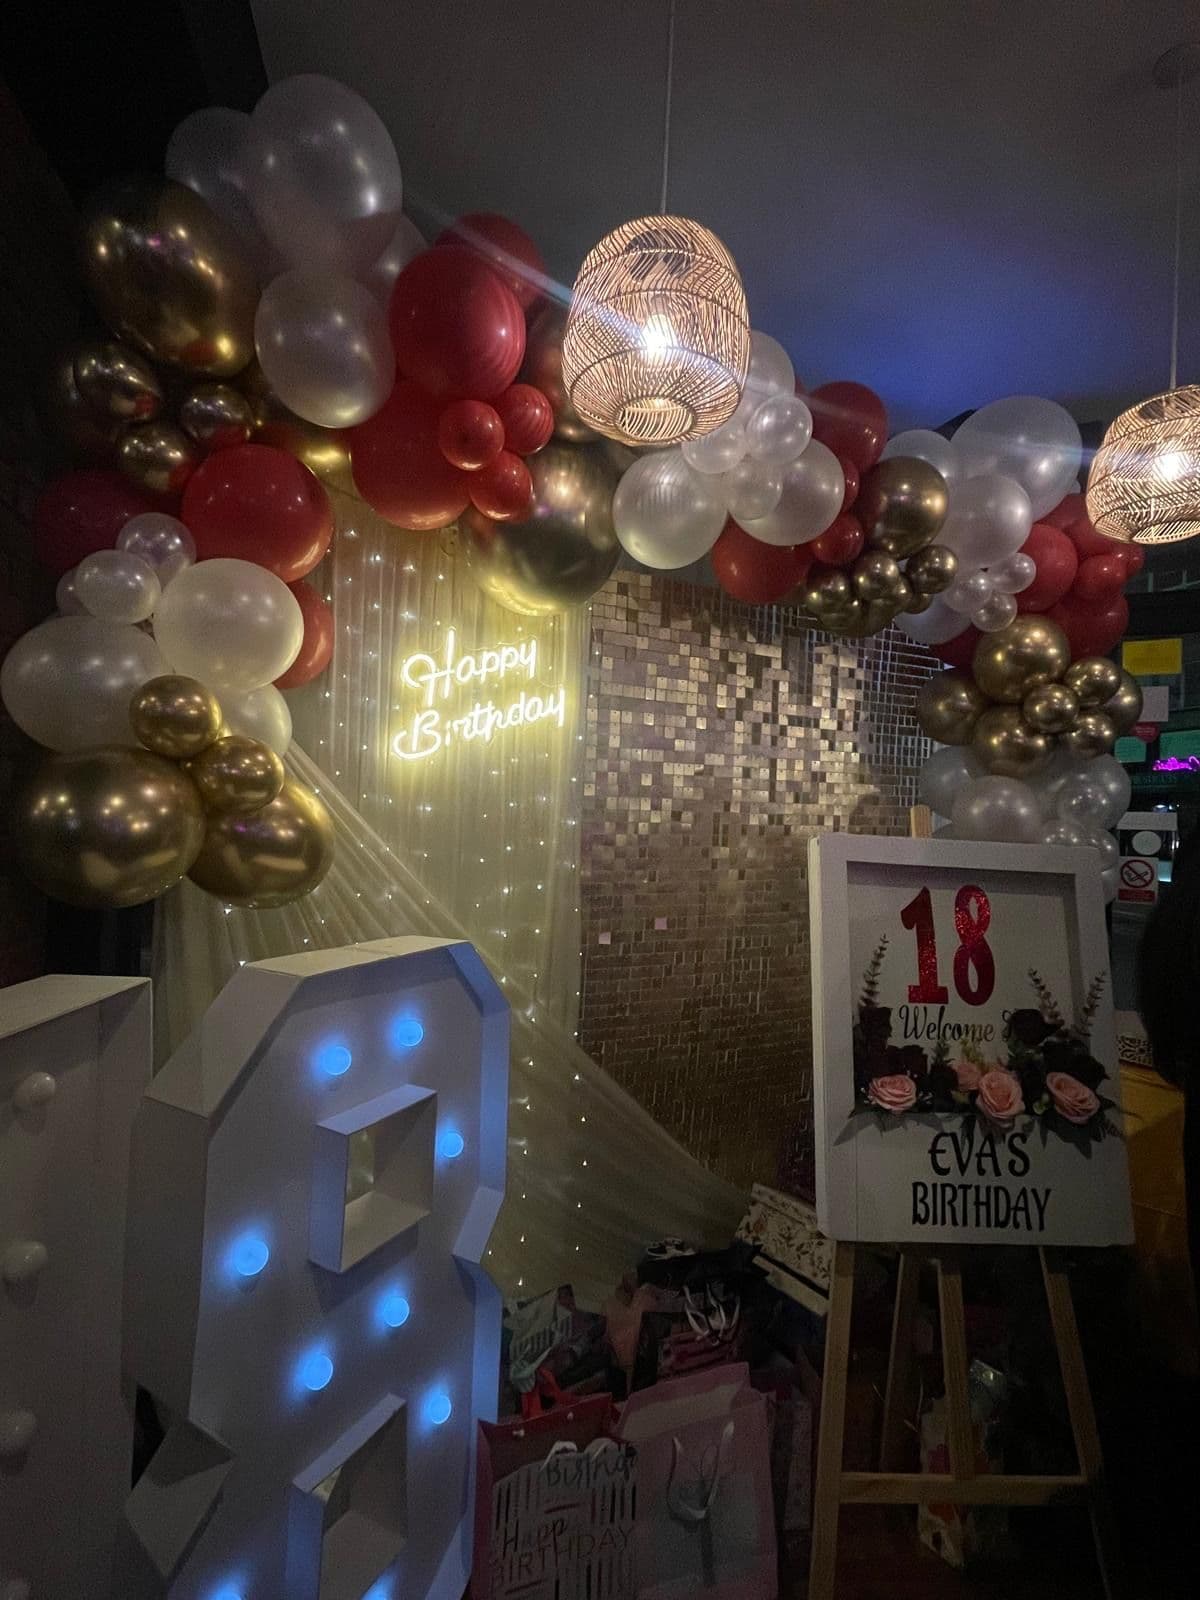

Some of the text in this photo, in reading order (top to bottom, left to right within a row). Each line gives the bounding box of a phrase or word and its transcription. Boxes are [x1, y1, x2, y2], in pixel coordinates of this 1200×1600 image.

[401, 626, 537, 706] Happy
[392, 686, 566, 760] Birthday
[900, 884, 996, 1006] 18
[899, 1004, 995, 1042] Welcome
[929, 1132, 1031, 1177] EVA'S
[912, 1181, 1051, 1232] BIRTHDAY
